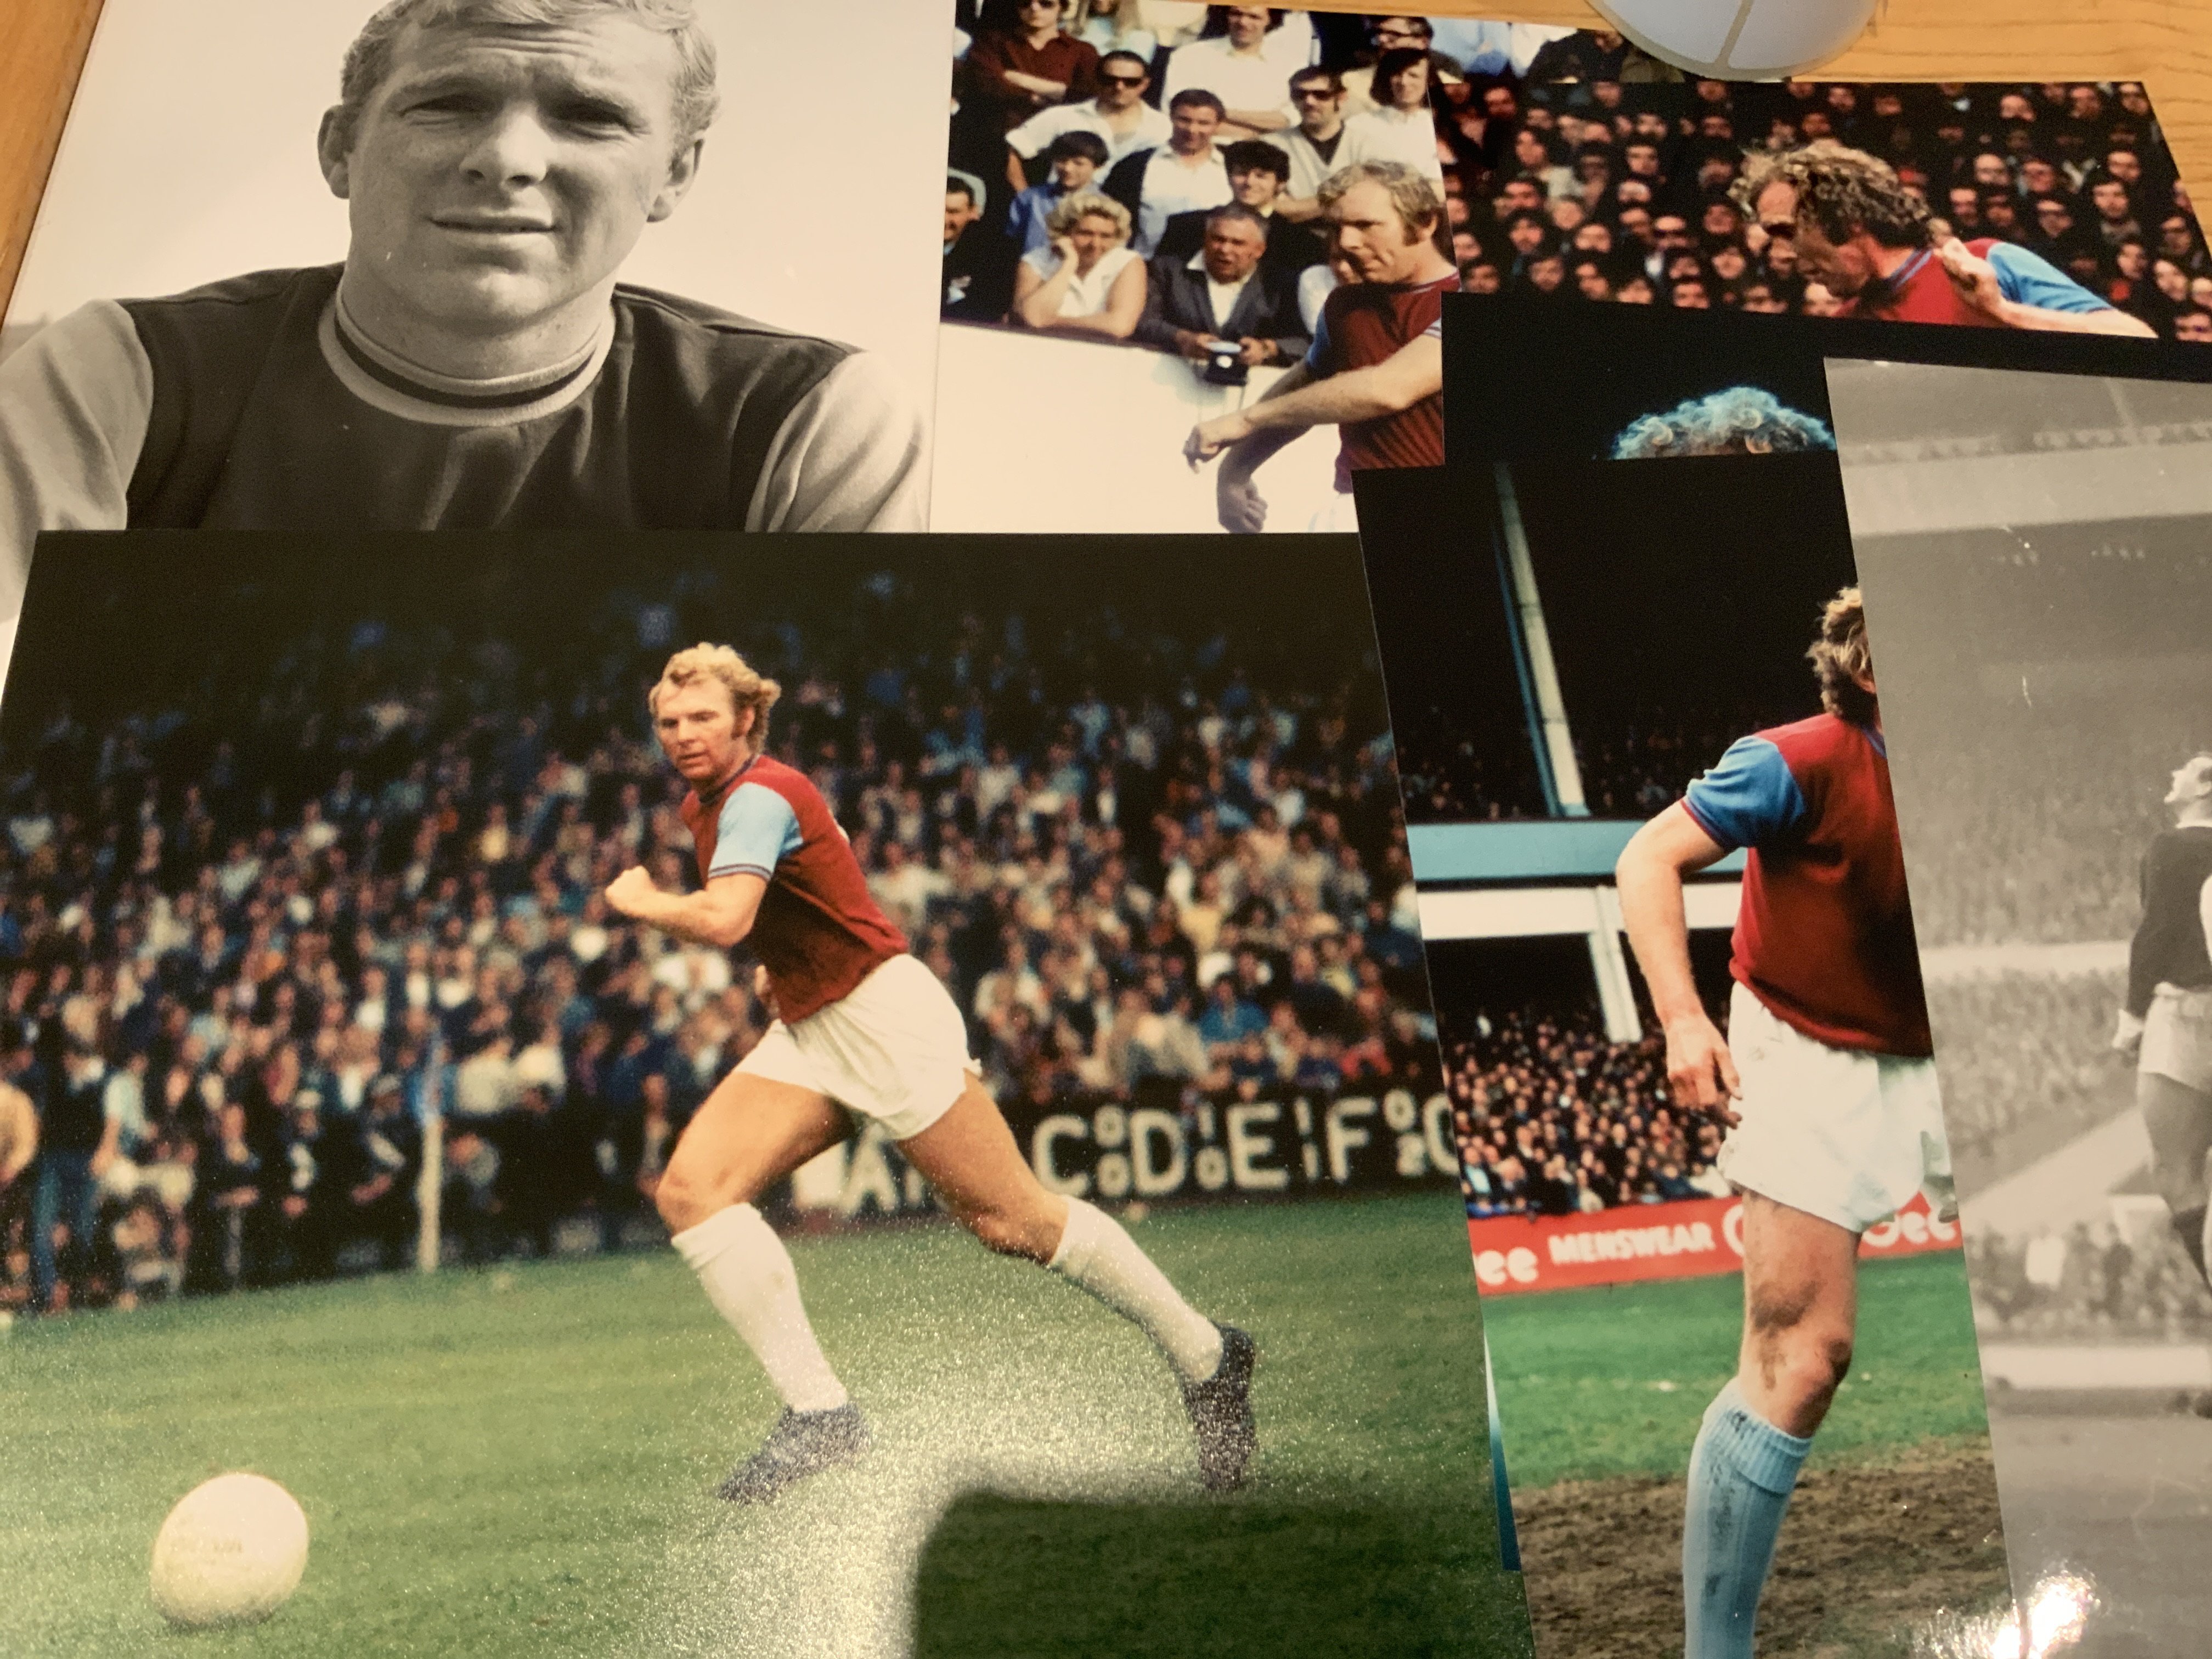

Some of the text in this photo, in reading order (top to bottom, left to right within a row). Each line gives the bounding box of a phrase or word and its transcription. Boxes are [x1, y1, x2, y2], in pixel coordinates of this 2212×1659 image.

[1031, 1114, 1090, 1197] C
[1129, 1108, 1188, 1194] D
[1226, 1102, 1289, 1190] E
[1325, 1096, 1378, 1184] F
[1472, 1246, 1539, 1286] ee
[1548, 1221, 1716, 1266] MENSWEAR
